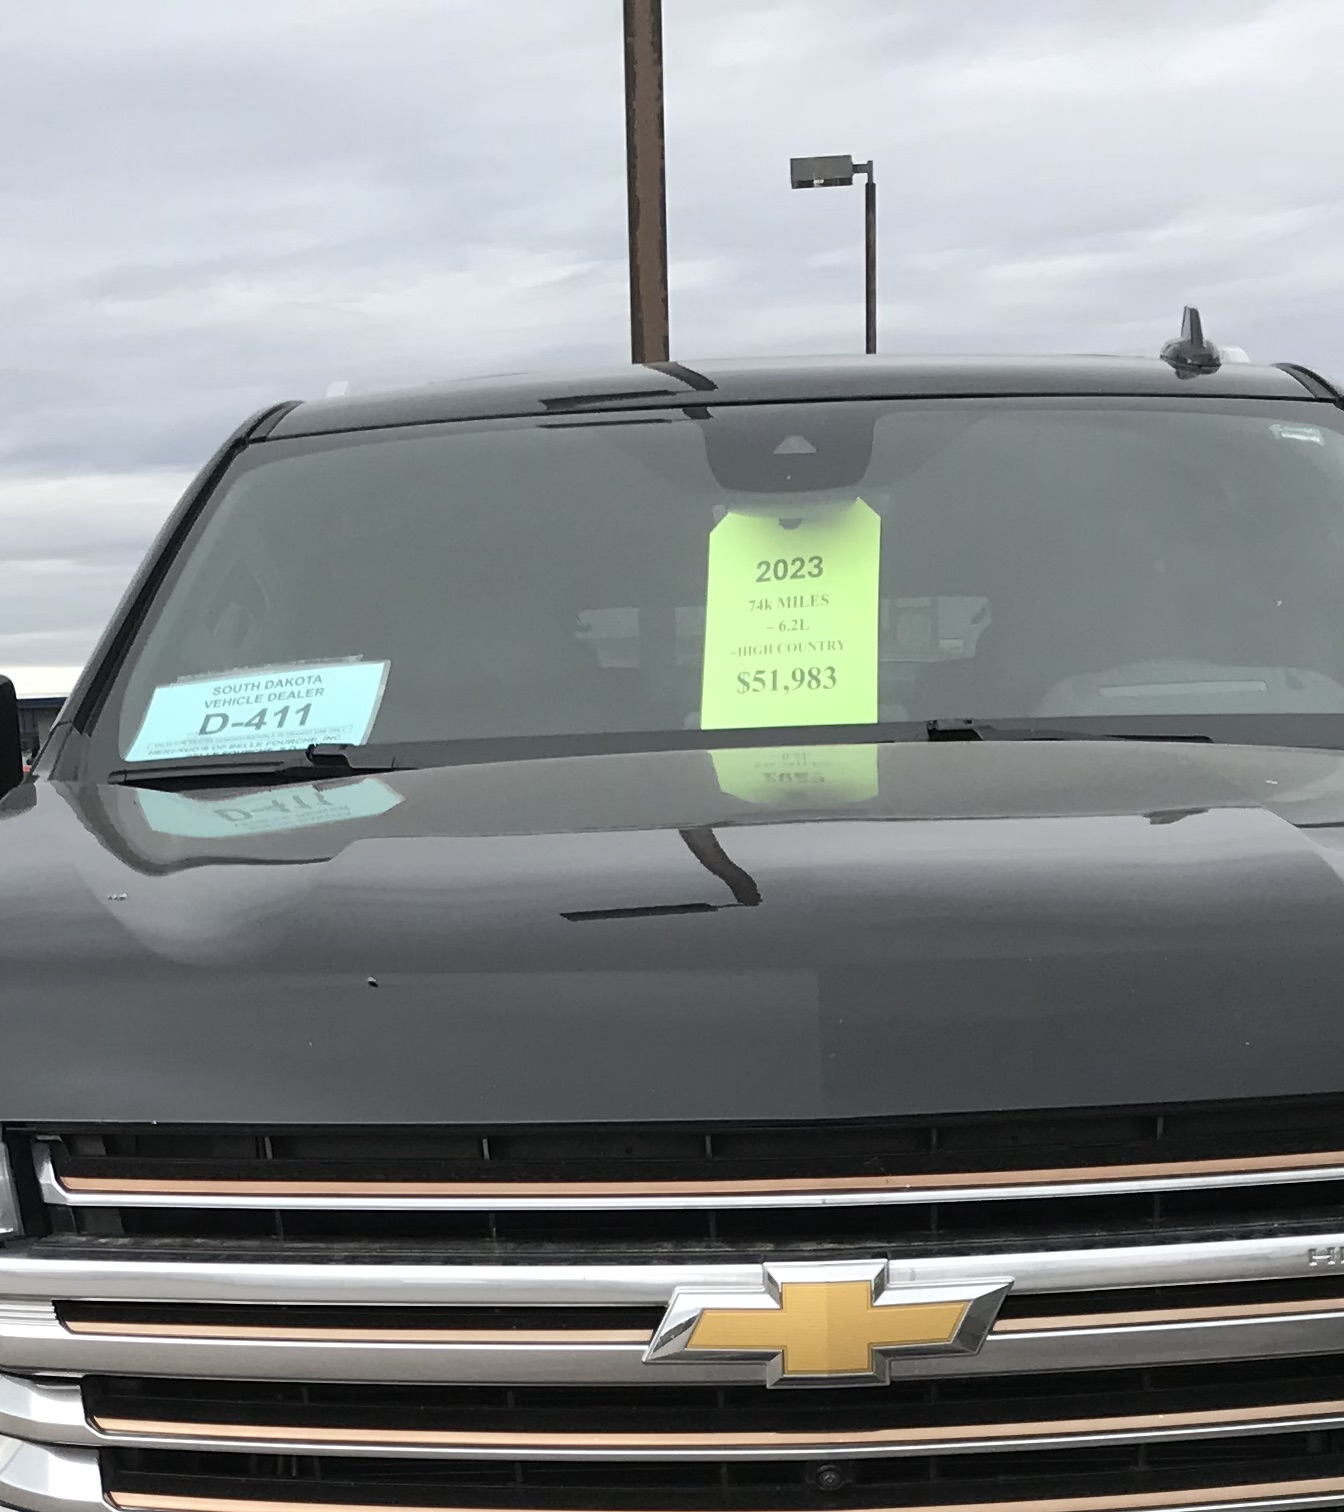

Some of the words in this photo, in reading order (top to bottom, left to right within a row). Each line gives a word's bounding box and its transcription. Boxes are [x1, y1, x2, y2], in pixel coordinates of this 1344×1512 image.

[755, 555, 824, 583] 2023
[748, 598, 773, 612] 74k
[777, 593, 830, 609] MILES
[778, 618, 810, 632] 6.2L
[776, 639, 847, 654] COUNTRY
[212, 681, 261, 696] SOUTH
[264, 674, 323, 690] DAKOTA
[736, 666, 838, 696] $51,983
[204, 693, 264, 709] VEHICLE
[267, 687, 325, 702] DEALER
[198, 702, 313, 736] D-411
